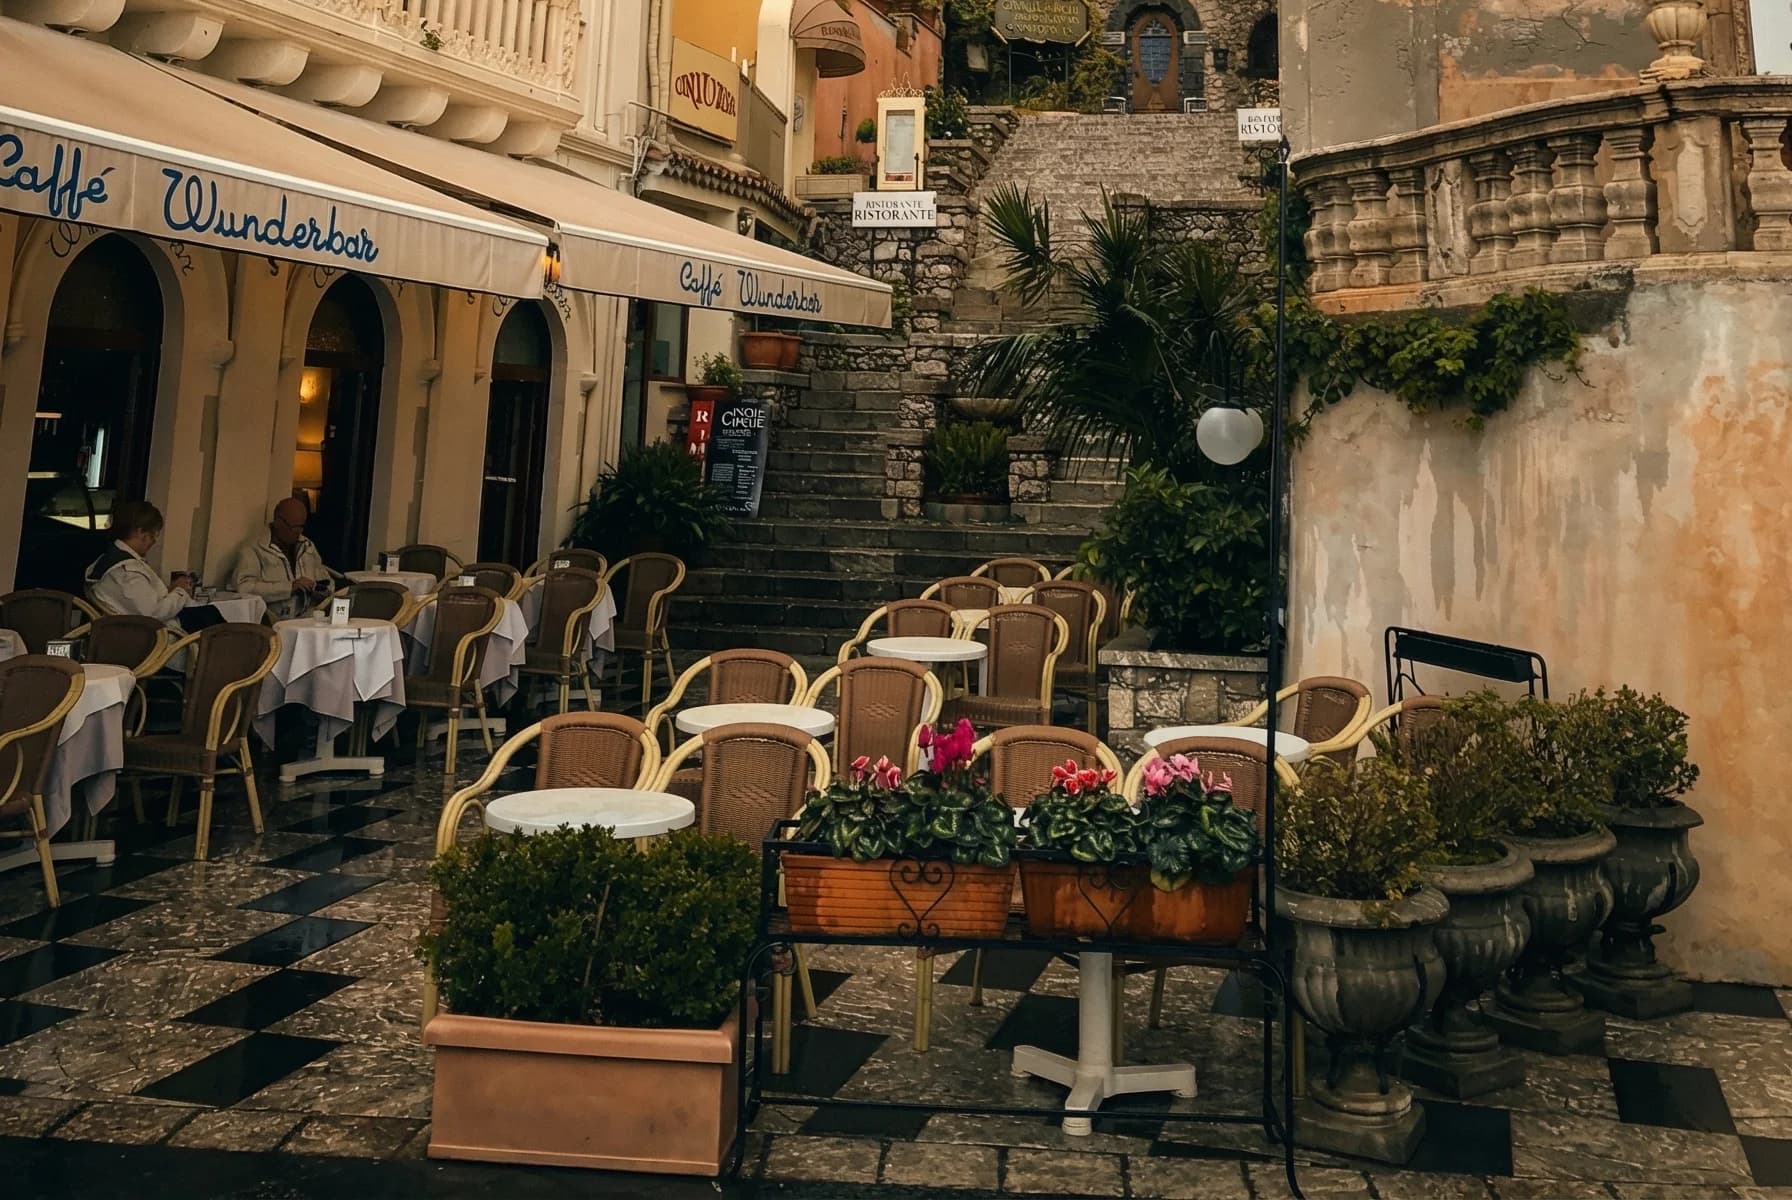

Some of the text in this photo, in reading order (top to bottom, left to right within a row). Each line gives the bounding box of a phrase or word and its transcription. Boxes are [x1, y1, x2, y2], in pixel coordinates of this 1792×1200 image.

[0, 134, 115, 220] Caffé
[162, 167, 379, 263] Wunderbar
[854, 209, 935, 220] RISTORANTE
